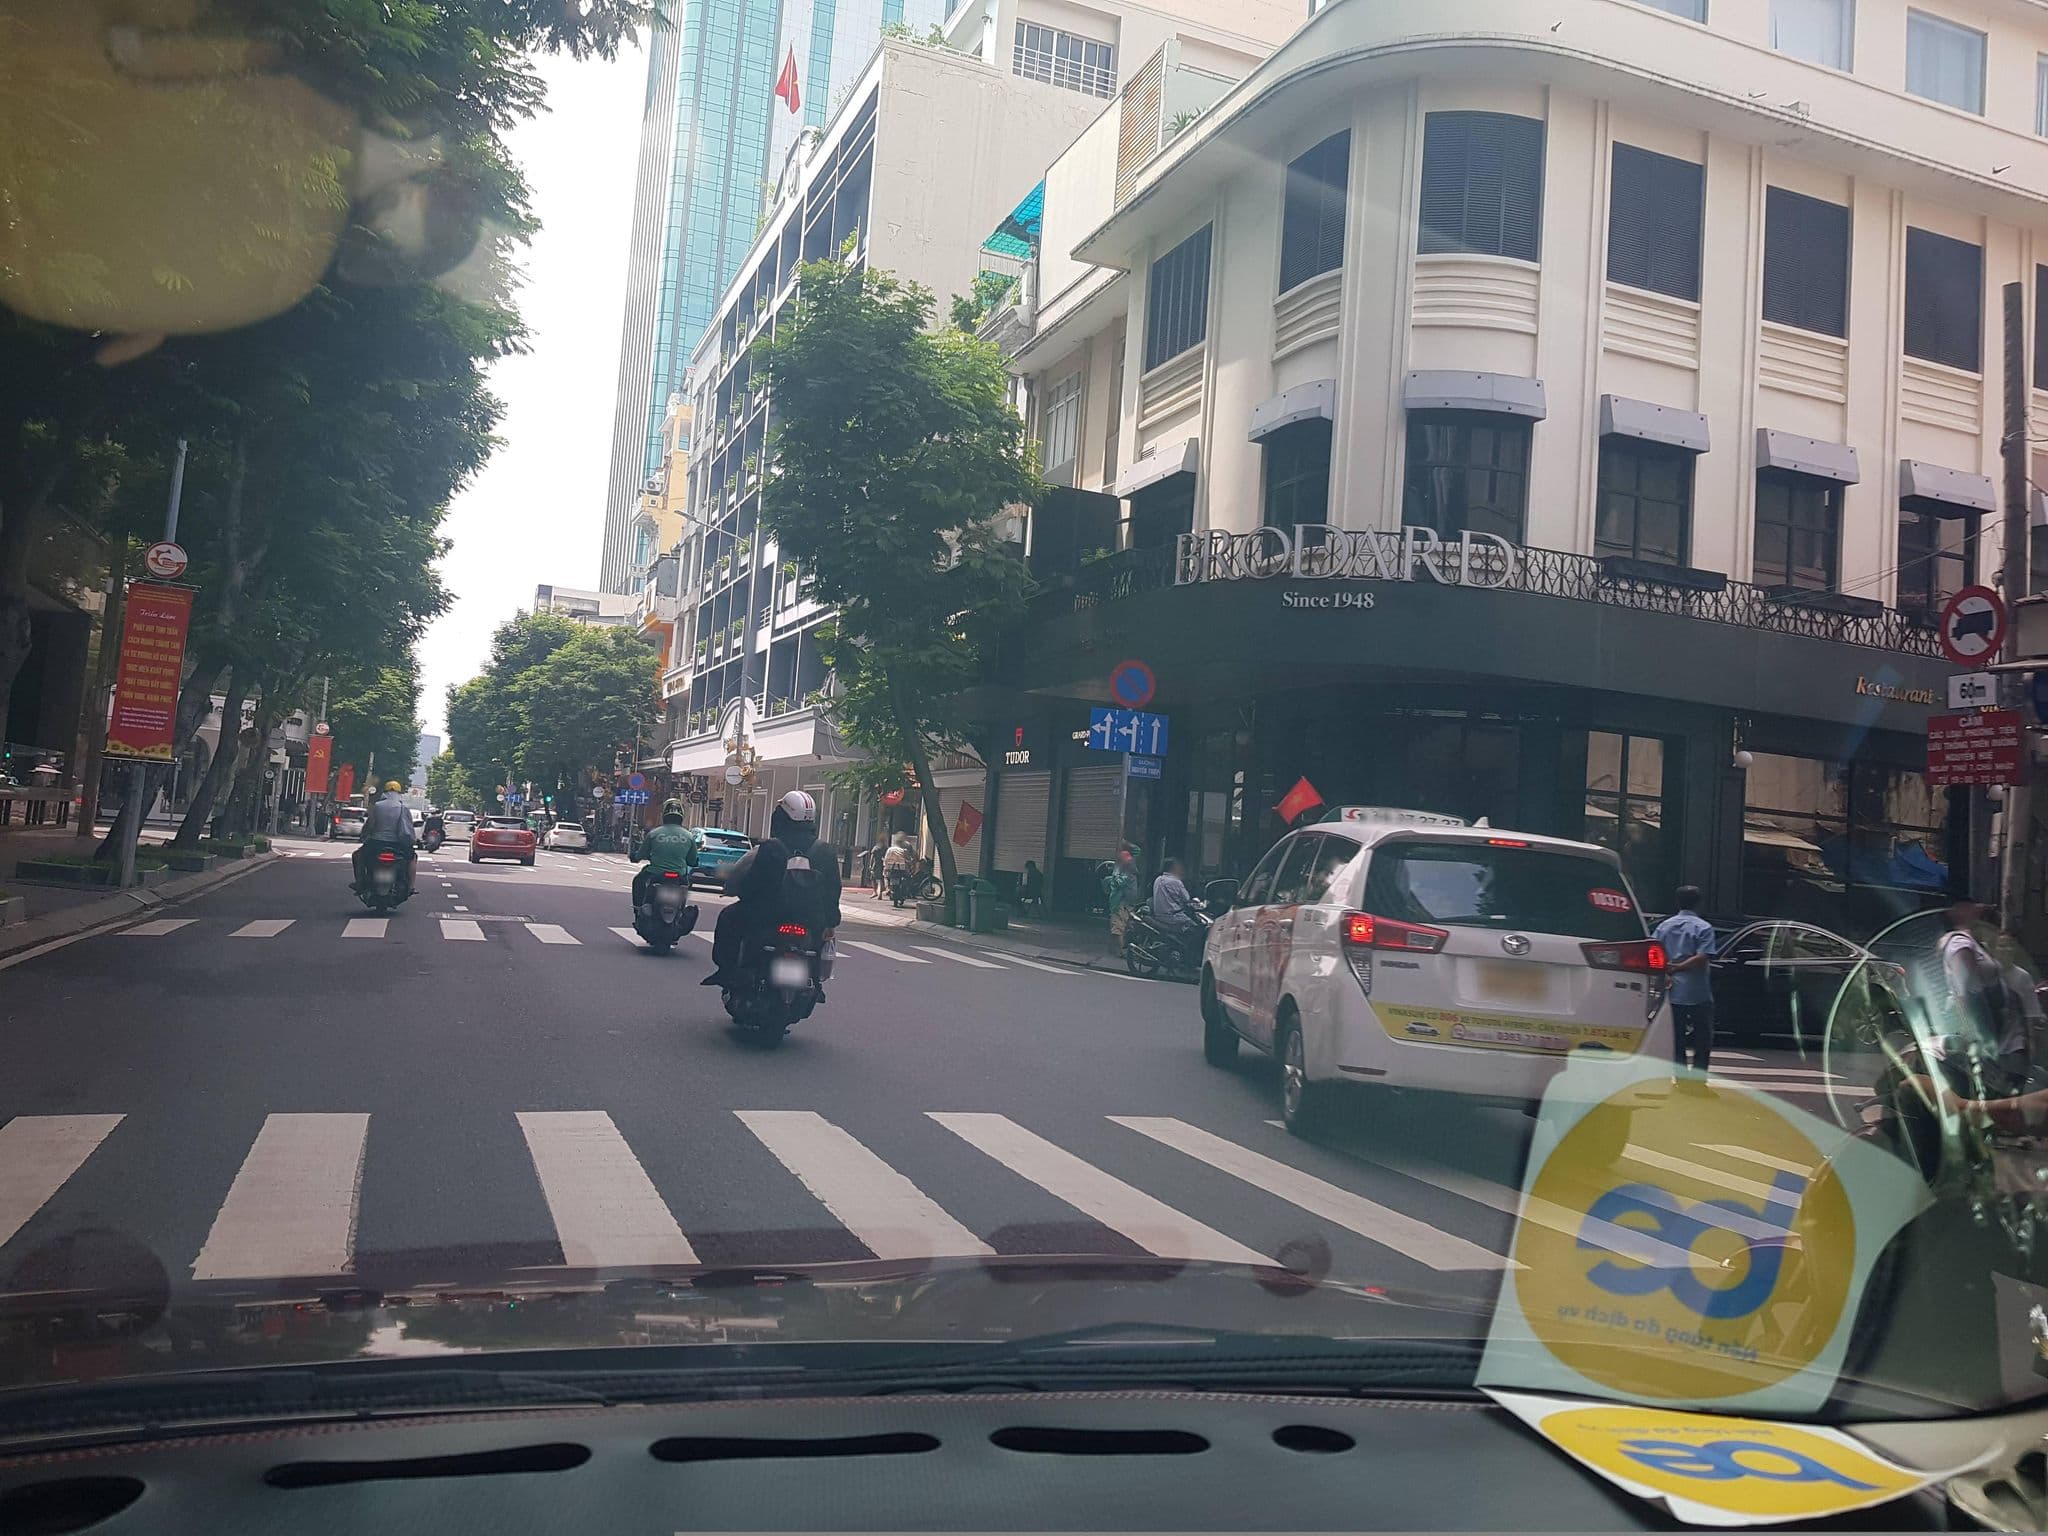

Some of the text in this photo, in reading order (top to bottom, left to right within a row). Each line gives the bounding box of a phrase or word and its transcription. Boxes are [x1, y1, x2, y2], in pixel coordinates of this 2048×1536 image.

[1173, 524, 1515, 589] BRODARD
[1282, 591, 1375, 609] Since 1948
[1856, 675, 1934, 704] Restaurant
[1959, 682, 1986, 699] 60m
[1005, 750, 1030, 765] TUDOR
[656, 833, 688, 844] Grab
[1590, 892, 1630, 910] 10372
